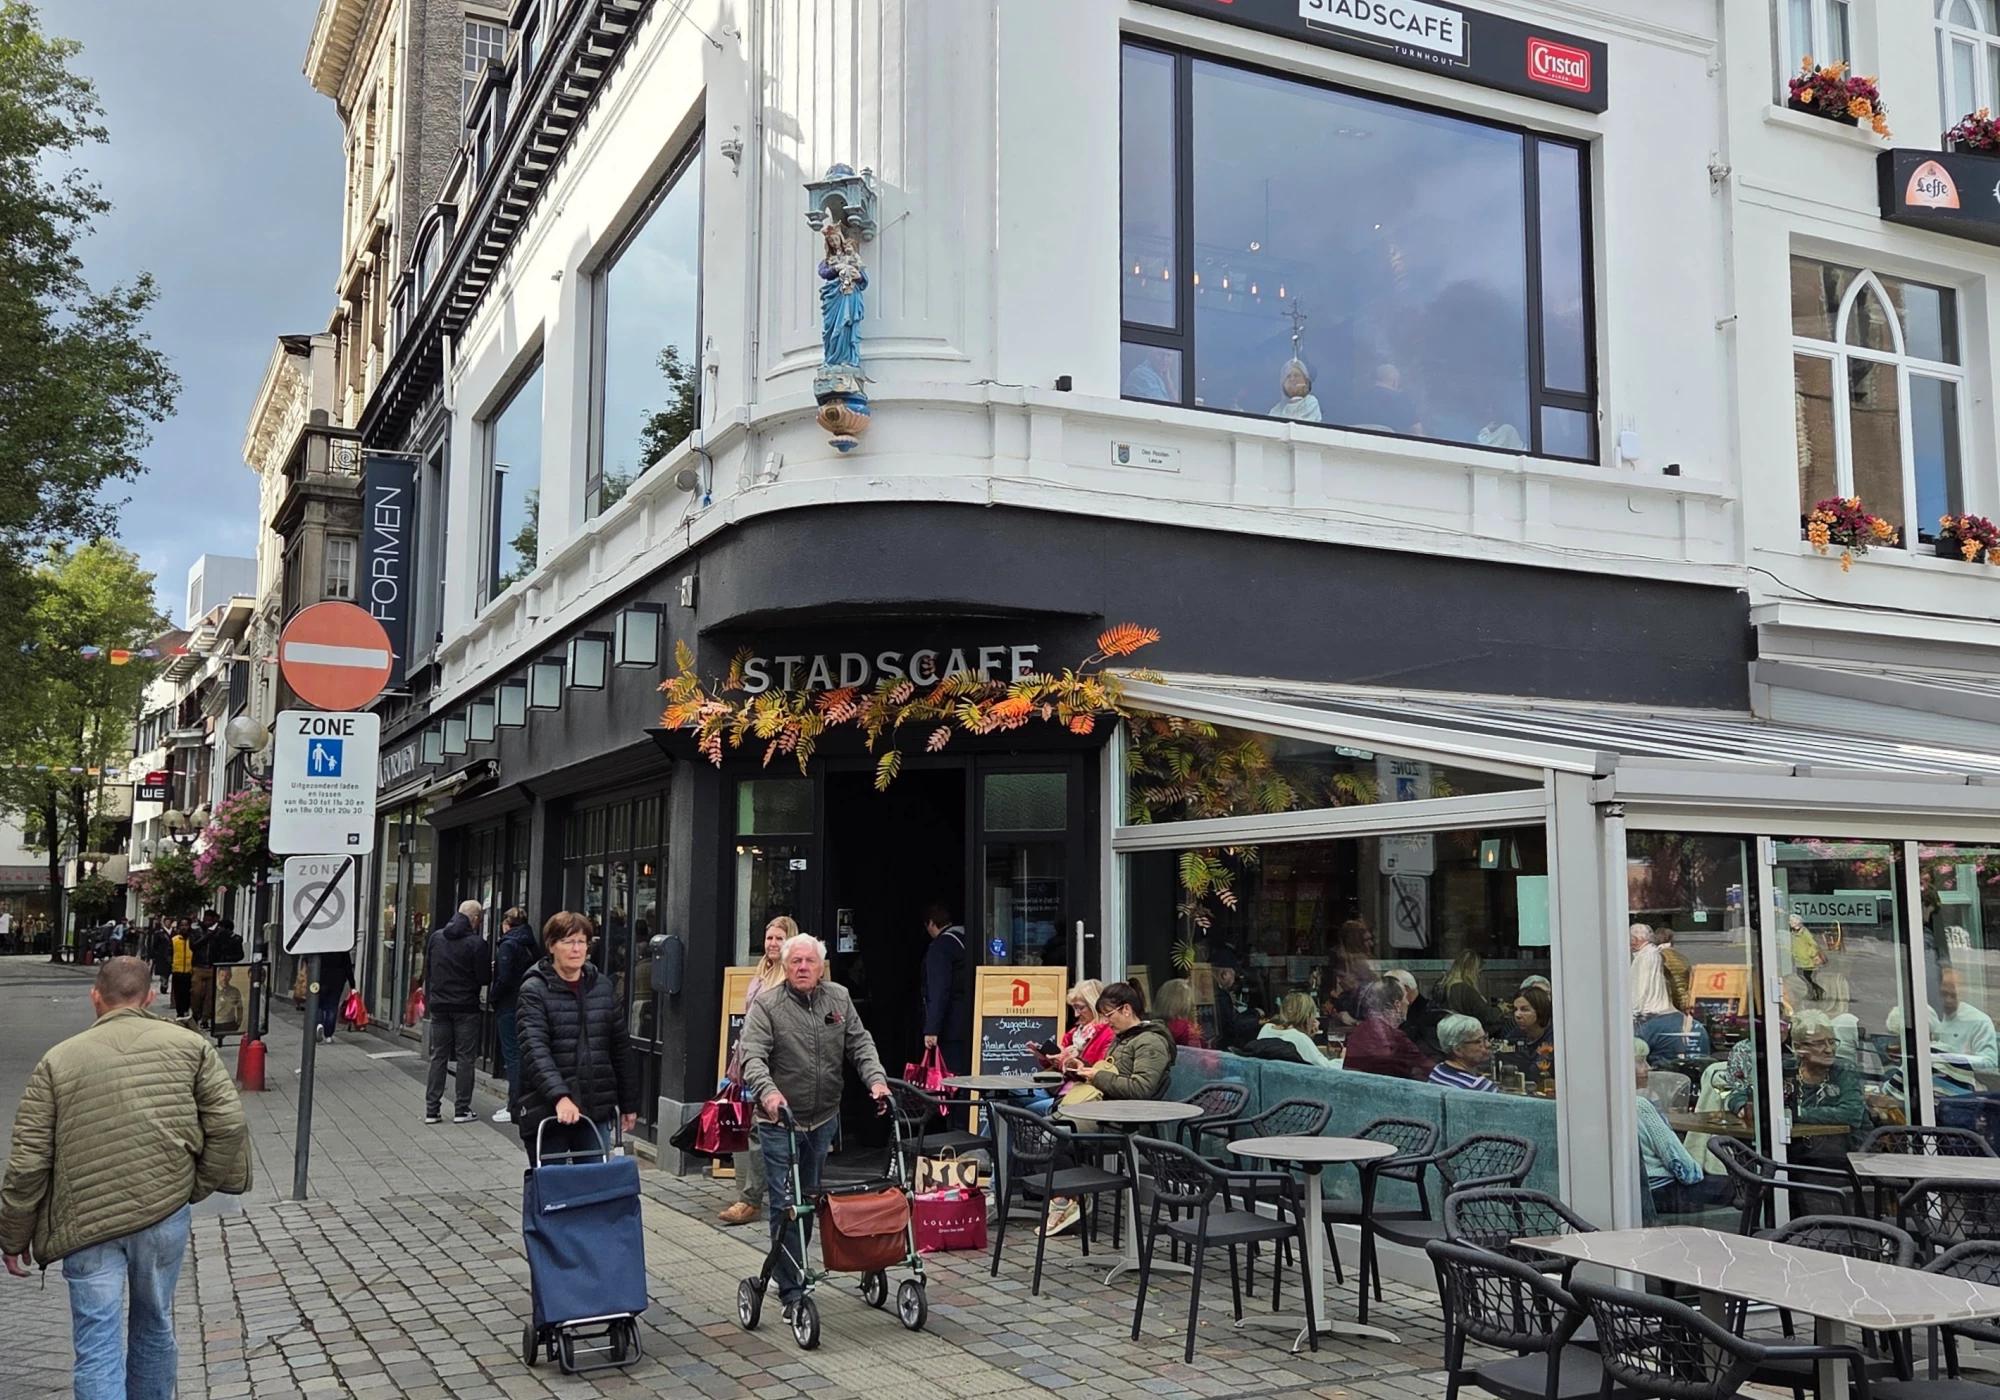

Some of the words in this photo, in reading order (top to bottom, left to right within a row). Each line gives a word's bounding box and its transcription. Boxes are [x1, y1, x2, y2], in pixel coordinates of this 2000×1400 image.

[1394, 45, 1454, 66] TURNHOUT
[1534, 46, 1584, 79] Cristal
[1916, 177, 1949, 198] Leffe
[298, 717, 355, 736] ZONE
[291, 782, 338, 790] Uitgezonderd
[340, 782, 359, 790] laden
[142, 788, 166, 799] WE
[308, 798, 319, 806] 30
[313, 806, 323, 814] 00
[299, 864, 341, 876] ZONE
[923, 1216, 980, 1226] LOLALIZA
